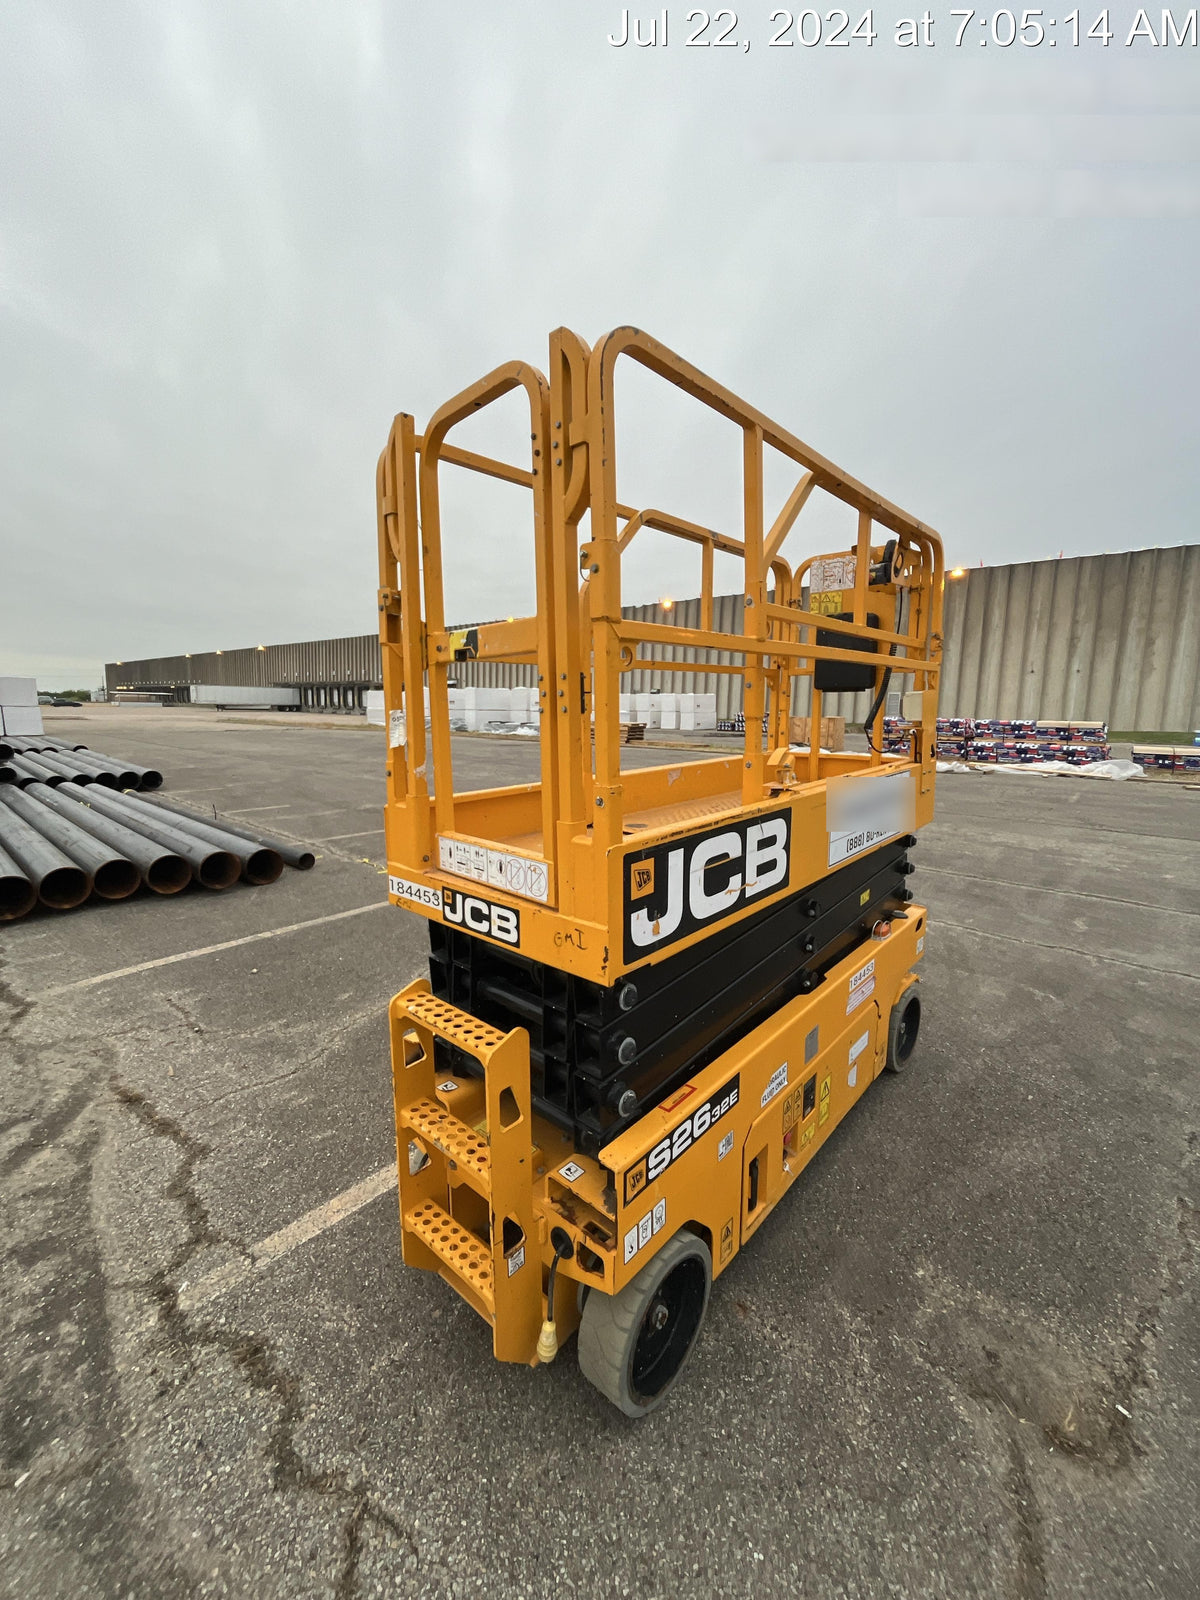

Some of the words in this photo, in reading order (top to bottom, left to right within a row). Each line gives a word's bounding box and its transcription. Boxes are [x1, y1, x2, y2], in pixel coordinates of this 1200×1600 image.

[389, 878, 441, 907] 184453
[631, 818, 788, 947] JCB
[443, 893, 519, 943] JCB
[849, 961, 874, 990] 184453
